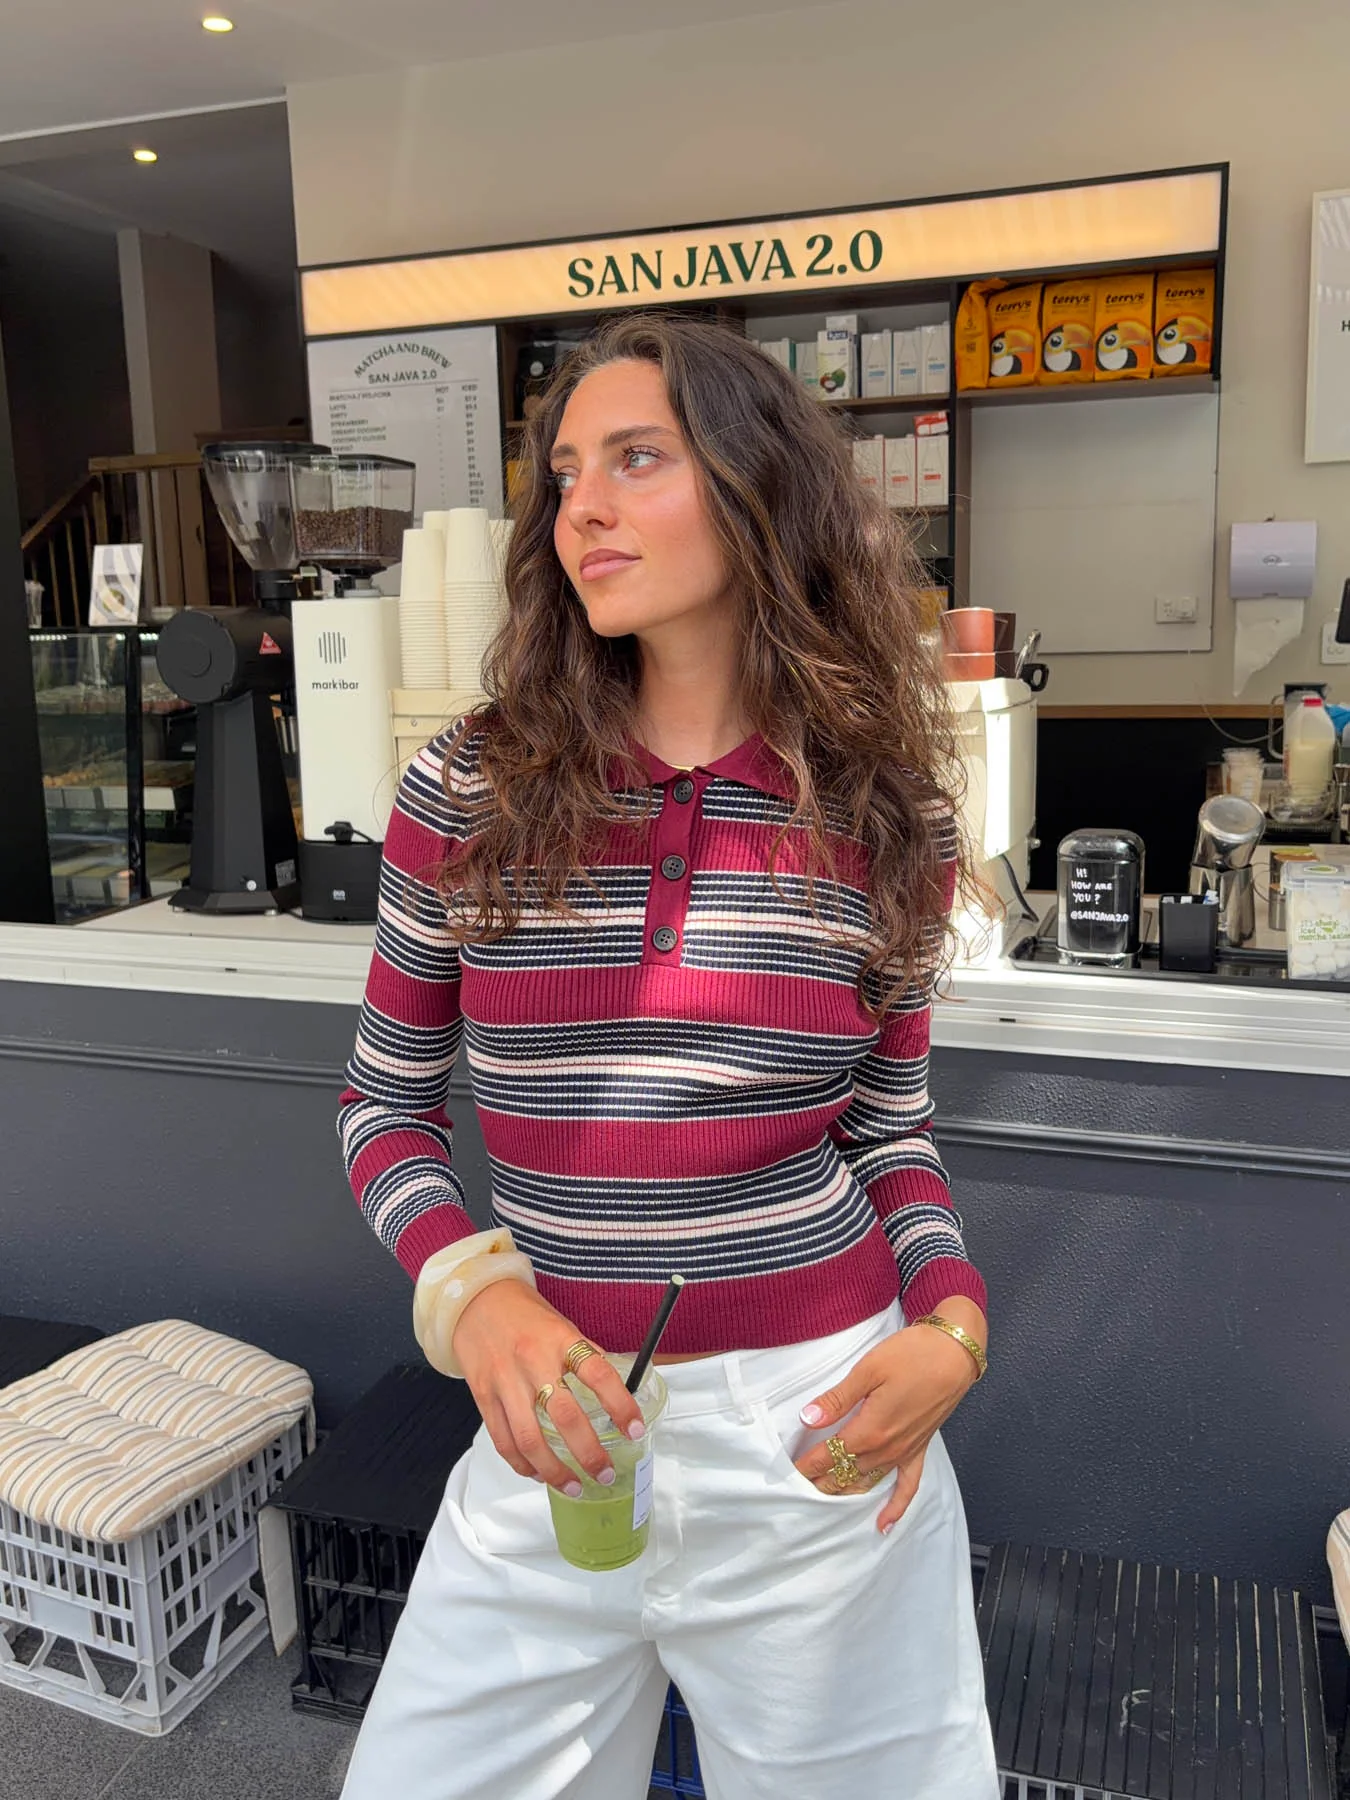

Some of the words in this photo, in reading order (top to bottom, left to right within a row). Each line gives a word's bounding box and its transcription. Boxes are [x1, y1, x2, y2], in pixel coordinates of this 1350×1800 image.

[568, 250, 663, 298] SAN
[673, 238, 797, 289] JAVA
[805, 229, 884, 277] 2.0
[1106, 291, 1145, 304] terry's
[1165, 287, 1206, 299] terry's
[1052, 294, 1091, 305] terry's
[995, 299, 1032, 313] terry's
[353, 344, 395, 378] MATCHA
[395, 342, 420, 354] AND
[421, 345, 453, 369] BREW
[368, 373, 390, 384] SAN
[392, 370, 419, 382] JAVA
[422, 369, 438, 381] 2.0
[312, 679, 359, 690] markibar
[1071, 880, 1092, 890] HOW
[1094, 882, 1112, 890] ARE
[1072, 892, 1092, 903] YOU
[1070, 910, 1129, 922] @SANJAVA2.0
